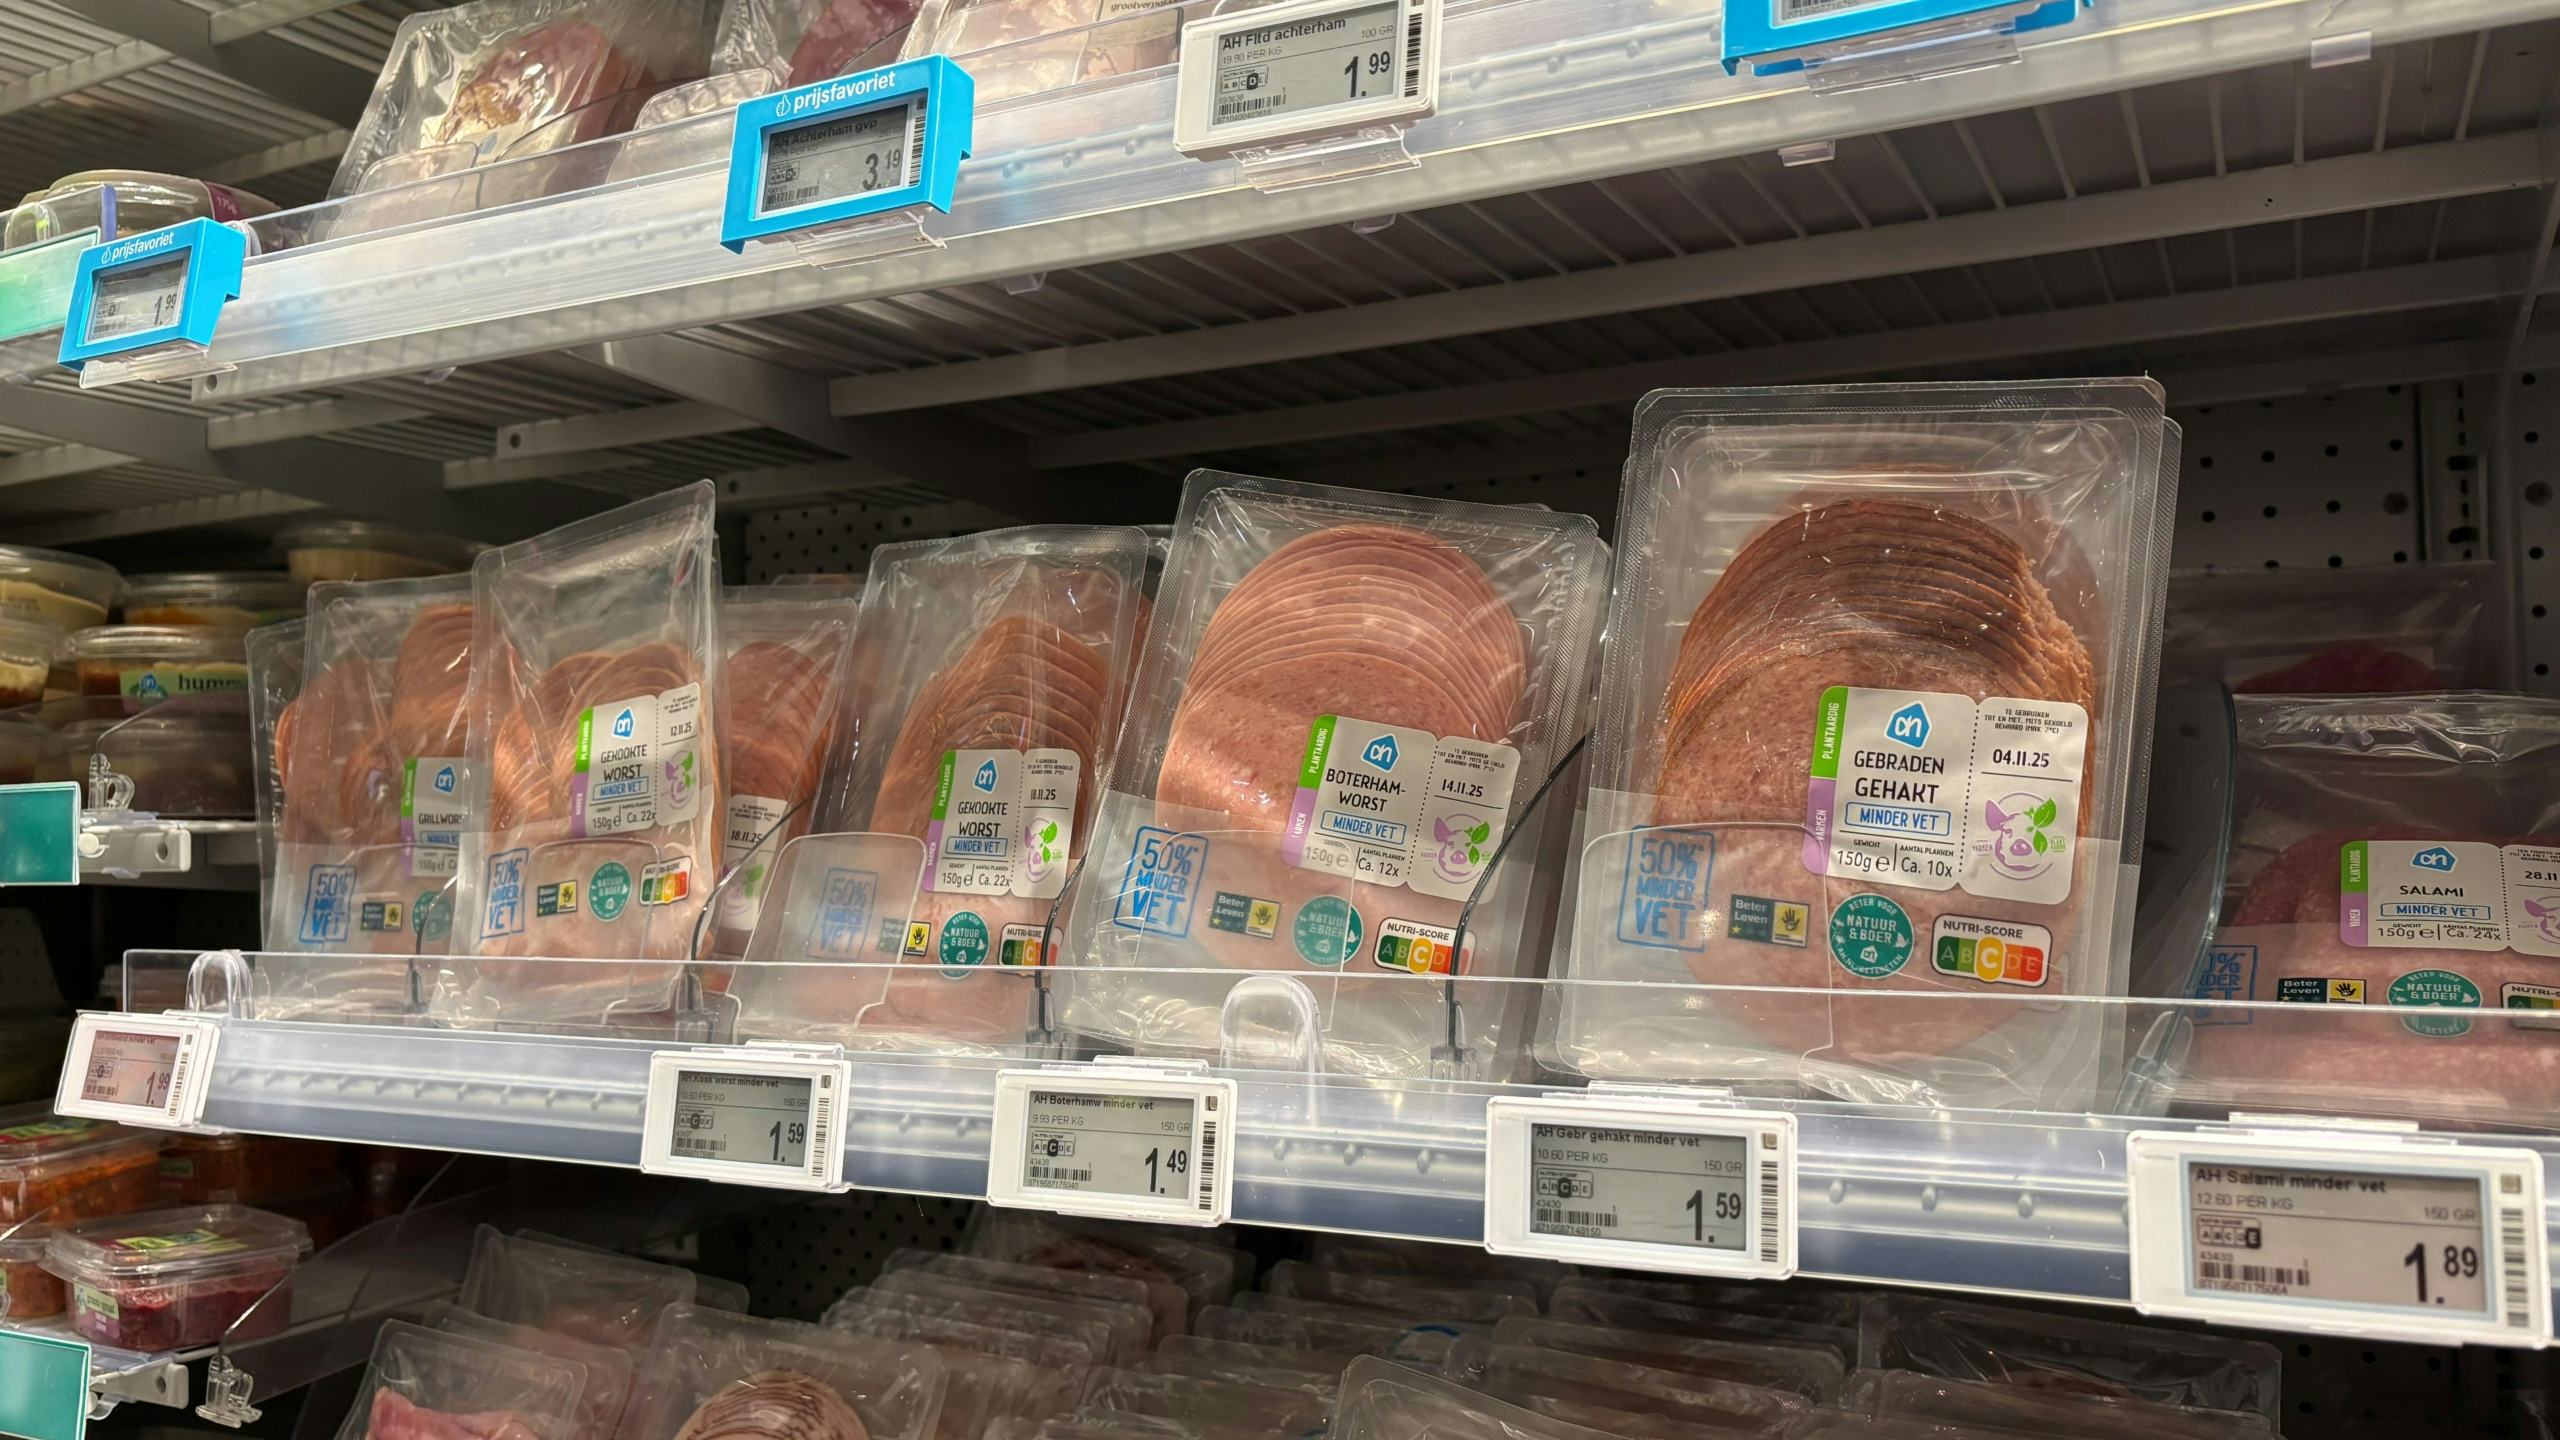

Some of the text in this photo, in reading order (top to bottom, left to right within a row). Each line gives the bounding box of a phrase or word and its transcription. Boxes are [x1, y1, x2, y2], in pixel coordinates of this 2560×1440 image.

[1223, 19, 1346, 50] AH Fltd achterham
[1362, 25, 1394, 38] 100 GR
[1247, 48, 1266, 59] PER
[1268, 47, 1282, 56] KG
[1344, 51, 1390, 98] 1.99
[794, 71, 896, 113] prijsfavoriet
[792, 125, 853, 144] Achterham
[855, 119, 877, 133] gvp
[862, 149, 901, 191] 3.19
[112, 232, 174, 262] prijsfavoriet
[2015, 710, 2050, 718] GEBRUIKEN
[1822, 702, 1840, 759] PLANTAARDIG
[2044, 719, 2072, 728] GEKOELD
[581, 720, 590, 760] PLANTAARDIG
[601, 744, 648, 764] GEKOOKTE
[1309, 728, 1329, 774] PLANTAARDIG
[1992, 749, 2050, 768] 04.11.25
[1854, 750, 1944, 775] GEBRADEN
[603, 764, 643, 782] WORST
[1326, 768, 1407, 795] BOTERHAM-
[600, 780, 643, 796] MINDER VET
[938, 764, 952, 806] PLANTAARDIG
[1442, 779, 1483, 797] 14.11.25
[1855, 777, 1939, 804] GEHAKT
[1031, 789, 1056, 800] 18.11.25
[1340, 791, 1387, 812] WORST
[627, 810, 656, 823] Ca. 22x
[958, 801, 1008, 815] GEKOOKTE
[593, 818, 612, 830] 150g
[1333, 815, 1398, 839] MINDER VET
[1860, 808, 1940, 830] MINDER VET
[959, 822, 1002, 837] WORST
[954, 840, 1000, 853] MINDER VET
[1854, 839, 1880, 848] GEWICHT
[1900, 845, 1954, 857] AANTAL PLAKKEN
[1306, 847, 1335, 867] 150g
[1363, 848, 1405, 861] AANTAL PLAKKEN
[1837, 850, 1872, 873] 150g
[1358, 857, 1400, 878] Ca. 12x
[1901, 857, 1953, 878] Ca. 10x
[942, 872, 962, 888] 150g
[979, 874, 1010, 887] Ca. 22x
[1136, 868, 1188, 895] MINDER
[1637, 875, 1695, 901] MINDER
[2400, 885, 2464, 897] SALAMI
[1132, 888, 1186, 927] VET
[1218, 895, 1245, 907] Beter
[1735, 898, 1766, 912] Beter
[1849, 898, 1897, 916] BETER VOOR
[1216, 905, 1244, 918] Leven
[1635, 897, 1696, 940] VET
[1734, 911, 1768, 925] Leven
[2396, 905, 2479, 917] MINDER VET
[1387, 922, 1450, 941] NUTRI-SCORE
[1847, 915, 1897, 933] NATUUR
[1943, 919, 2023, 939] NUTRI-SCORE
[950, 928, 979, 938] NATUUR
[1007, 928, 1042, 938] NUTRI-SCORE
[1849, 928, 1892, 944] & BOER
[2377, 928, 2415, 939] 150g
[2447, 929, 2501, 941] Ca. 24x
[958, 938, 976, 947] BOER
[2408, 972, 2435, 982] BETER
[2406, 983, 2462, 992] NATUUR
[2423, 991, 2457, 1000] BOER
[715, 1077, 736, 1086] worst
[738, 1077, 764, 1087] minder
[766, 1080, 779, 1088] vet
[1033, 1095, 1154, 1110] AH Boterhamw minder vet
[1052, 1115, 1070, 1124] PER
[1072, 1116, 1084, 1125] KG
[1161, 1121, 1190, 1132] 150 GR
[769, 1121, 804, 1162] 1.59
[1536, 1126, 1700, 1147] AH Gebr gehakt minder vet
[1566, 1151, 1590, 1162] PER
[1593, 1152, 1608, 1164] KG
[1145, 1147, 1188, 1194] 1.49
[1704, 1160, 1742, 1173] 150 GR
[2196, 1169, 2387, 1194] AH Salami minder vet
[2236, 1193, 2267, 1209] PER
[2270, 1196, 2294, 1210] KG
[1686, 1190, 1741, 1242] 1.59
[2424, 1206, 2476, 1222] 150 GR
[2404, 1242, 2478, 1305] 1.89
